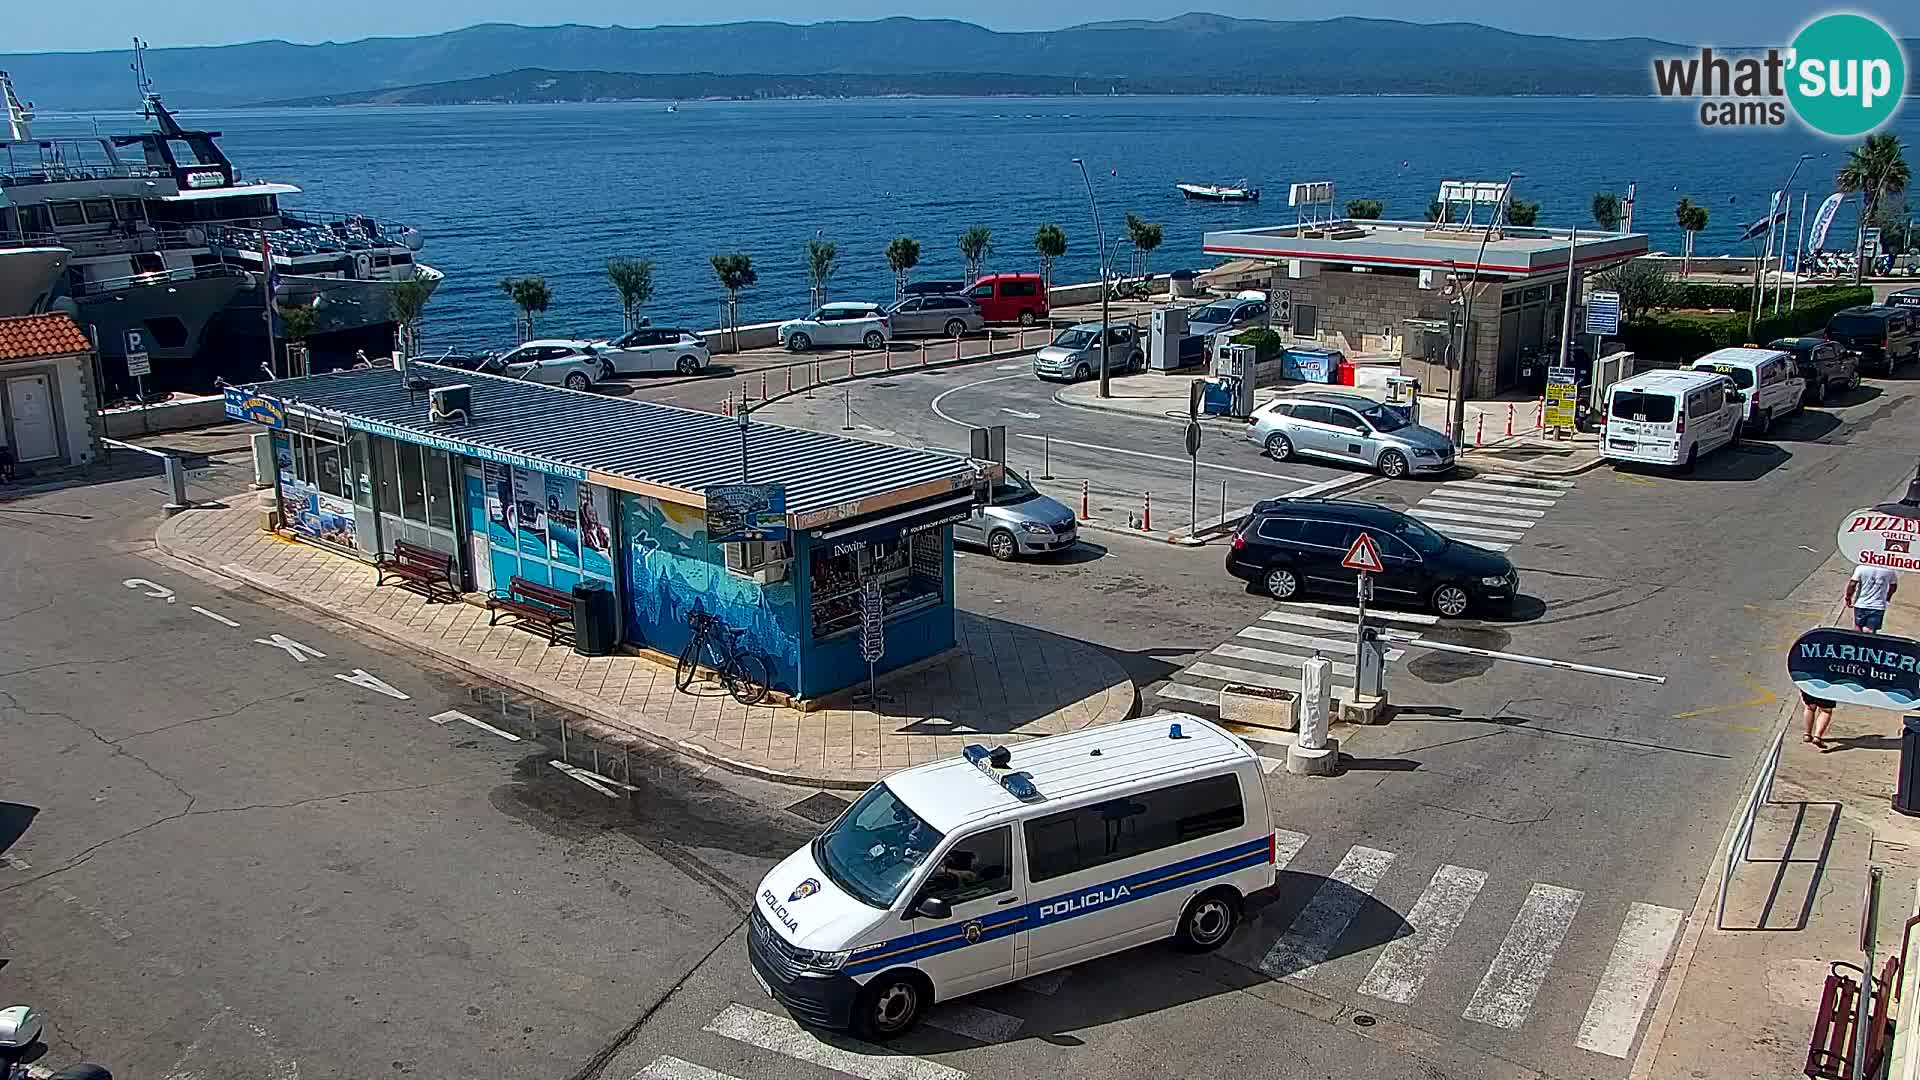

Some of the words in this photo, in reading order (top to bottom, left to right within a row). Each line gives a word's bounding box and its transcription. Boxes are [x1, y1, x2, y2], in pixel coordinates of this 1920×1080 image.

[129, 332, 141, 351] P
[1715, 365, 1733, 373] TAXI
[435, 439, 467, 453] POSTAJA
[477, 448, 492, 460] BUS
[492, 450, 526, 468] STATION
[526, 458, 554, 474] TICKET
[553, 464, 582, 479] OFFICE
[1848, 516, 1920, 534] PIZZE
[1881, 531, 1917, 541] GRILL
[1829, 662, 1866, 677] caffe
[1870, 666, 1897, 681] bar
[1040, 884, 1131, 919] POLICIJA
[761, 889, 799, 934] POLICIJA
